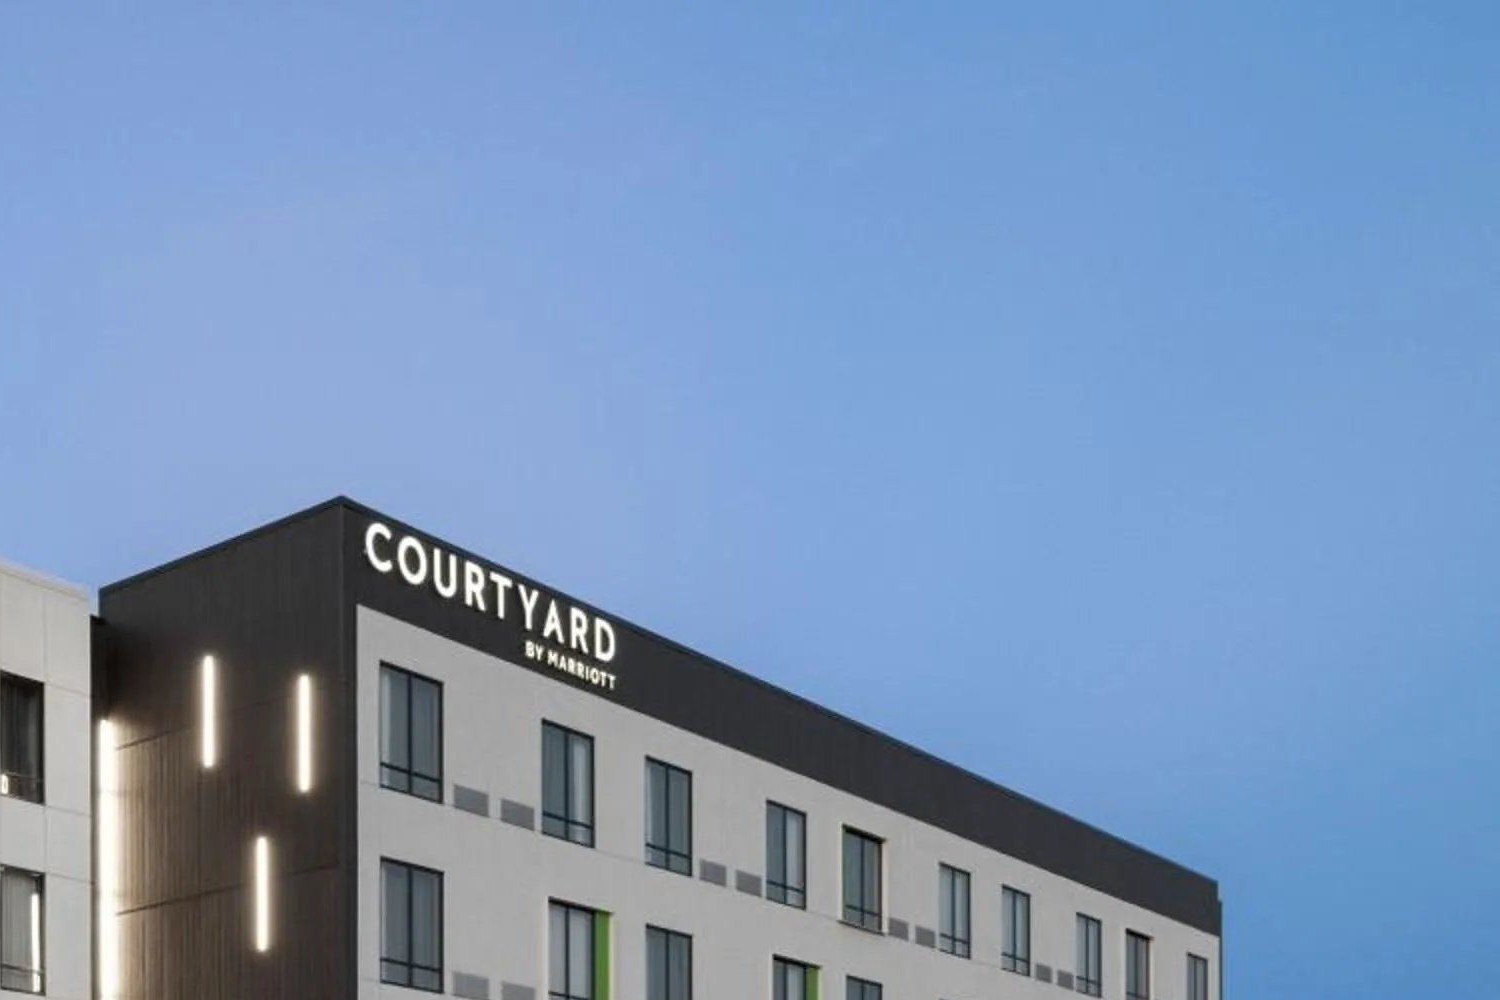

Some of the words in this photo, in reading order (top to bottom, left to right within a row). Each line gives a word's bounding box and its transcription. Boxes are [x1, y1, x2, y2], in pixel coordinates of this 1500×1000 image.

[365, 523, 616, 662] COURTYARD
[525, 640, 544, 661] BY
[547, 649, 616, 690] MARRIOTT
